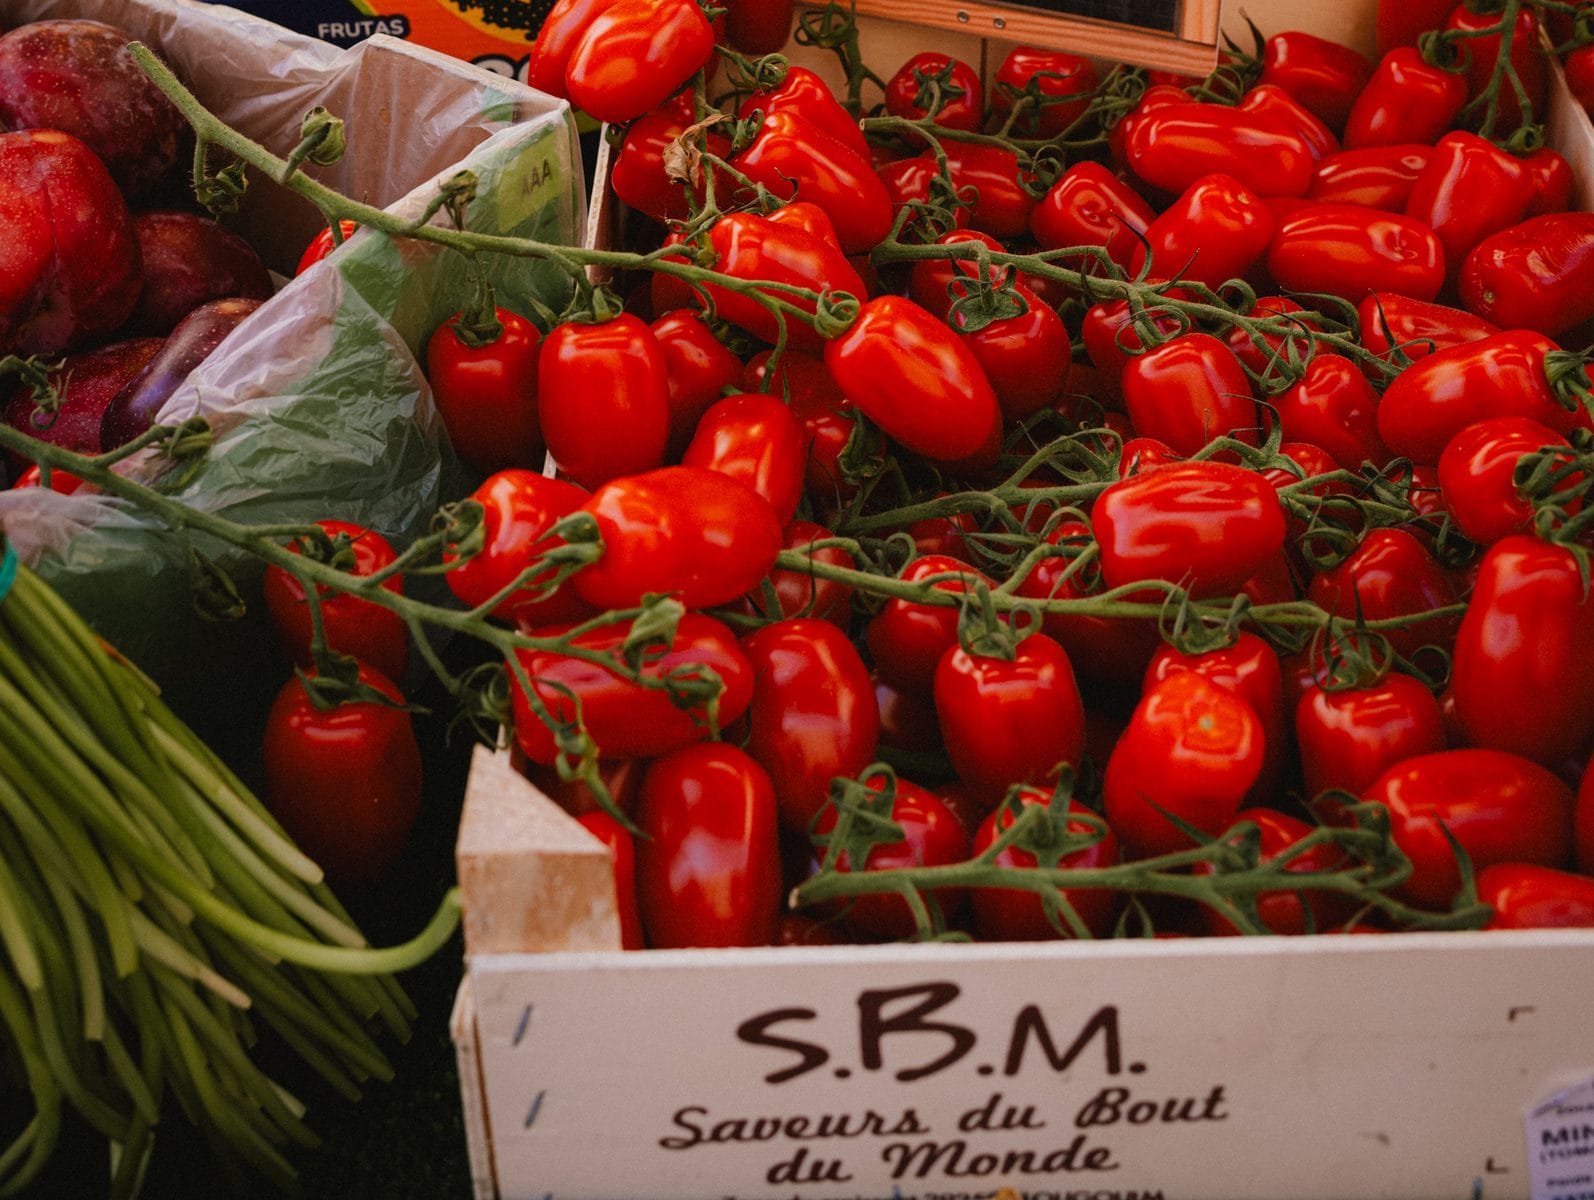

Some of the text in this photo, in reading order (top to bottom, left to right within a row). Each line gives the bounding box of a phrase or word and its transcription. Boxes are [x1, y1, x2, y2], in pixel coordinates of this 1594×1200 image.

[318, 19, 404, 39] FRUTAS
[658, 1085, 1230, 1150] Saveurs du Bout
[765, 1134, 1120, 1186] du Monde
